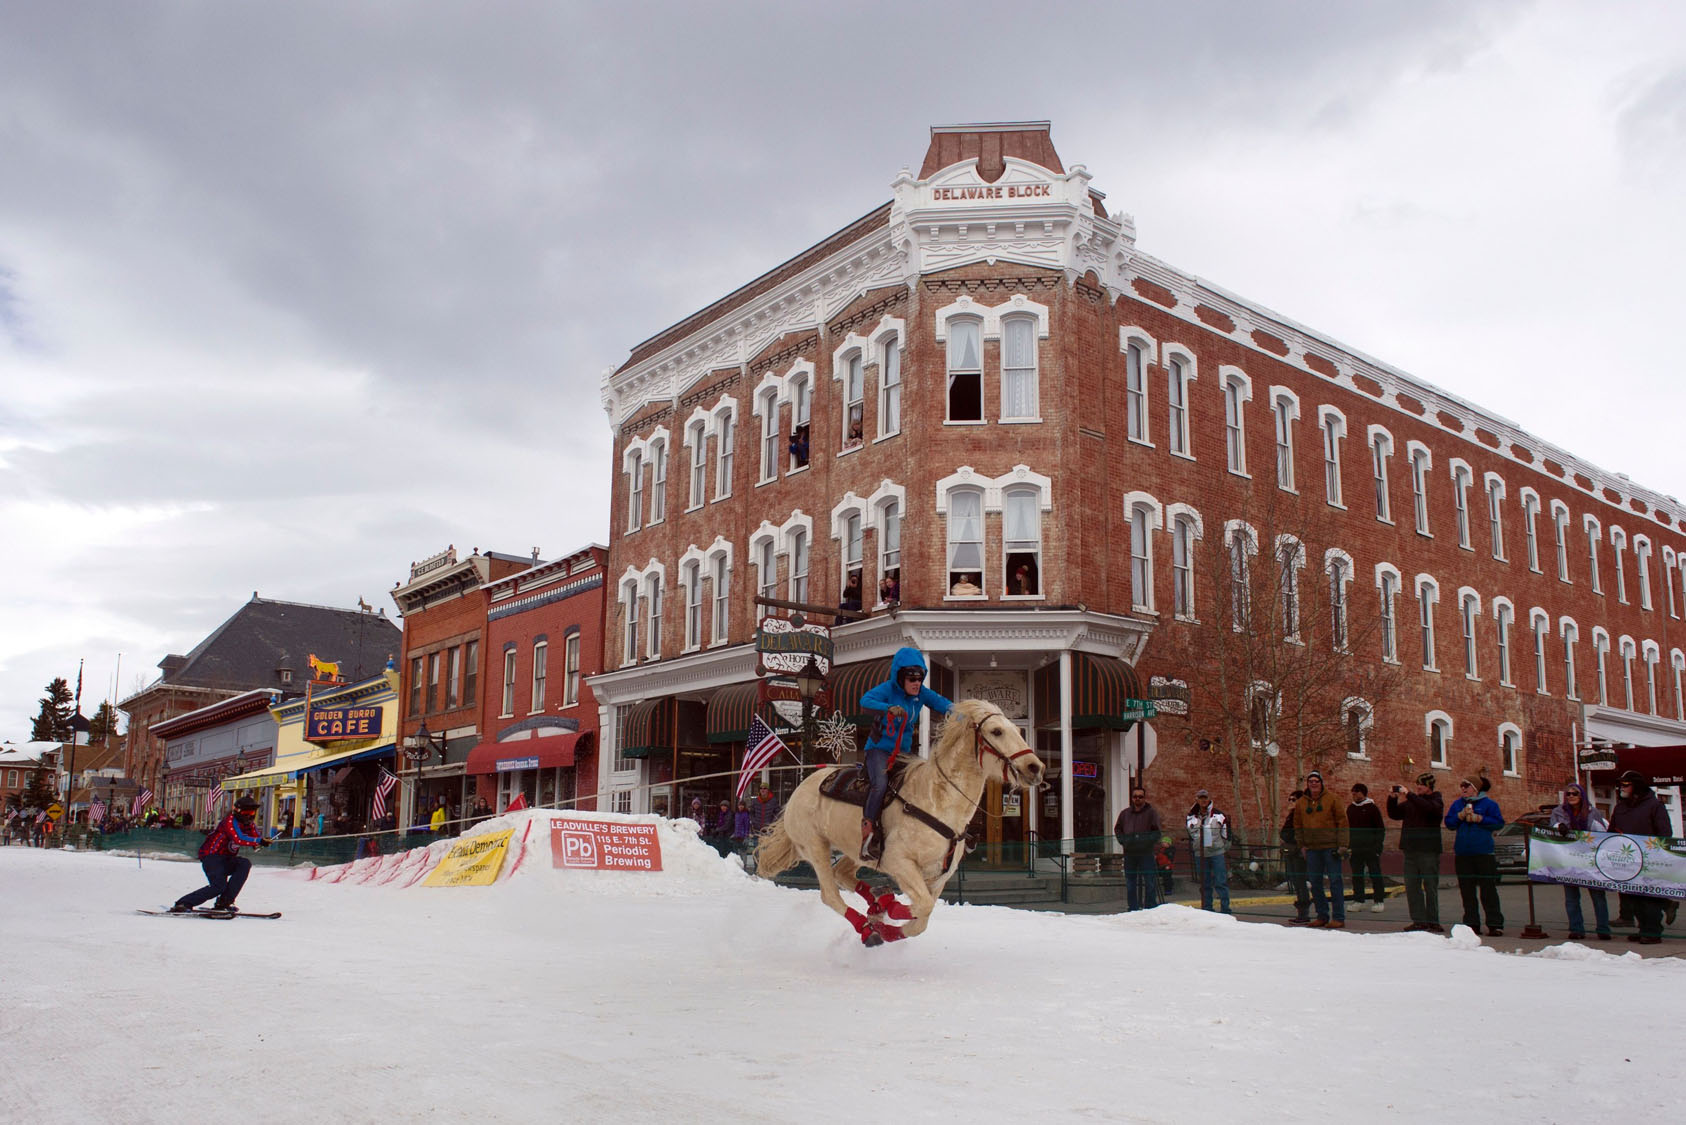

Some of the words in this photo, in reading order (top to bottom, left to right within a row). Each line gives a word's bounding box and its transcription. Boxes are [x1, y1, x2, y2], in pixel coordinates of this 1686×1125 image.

[934, 187, 1003, 200] DELAWARE
[1008, 185, 1050, 198] BLOCK
[761, 633, 831, 656] DELAWARE
[1126, 699, 1131, 707] E
[1134, 700, 1144, 709] 7TH
[1146, 701, 1153, 709] ST
[314, 711, 343, 720] GOLDEN
[348, 709, 376, 719] BURRO
[1123, 711, 1144, 720] HARRISON
[1147, 709, 1156, 717] AVE
[317, 719, 369, 735] CAFE
[1073, 763, 1095, 775] OPEN
[1004, 796, 1020, 804] OEN
[551, 821, 608, 833] LEADVILLE'S
[610, 825, 655, 835] BREWERY
[597, 835, 611, 843] 115
[613, 836, 622, 844] E.
[624, 836, 637, 845] 7th
[639, 837, 652, 845] St.
[566, 838, 592, 857] Pb
[604, 845, 648, 856] Periodic
[605, 855, 651, 868] Brewing
[1556, 875, 1685, 897] www.naturesspirit420.com
